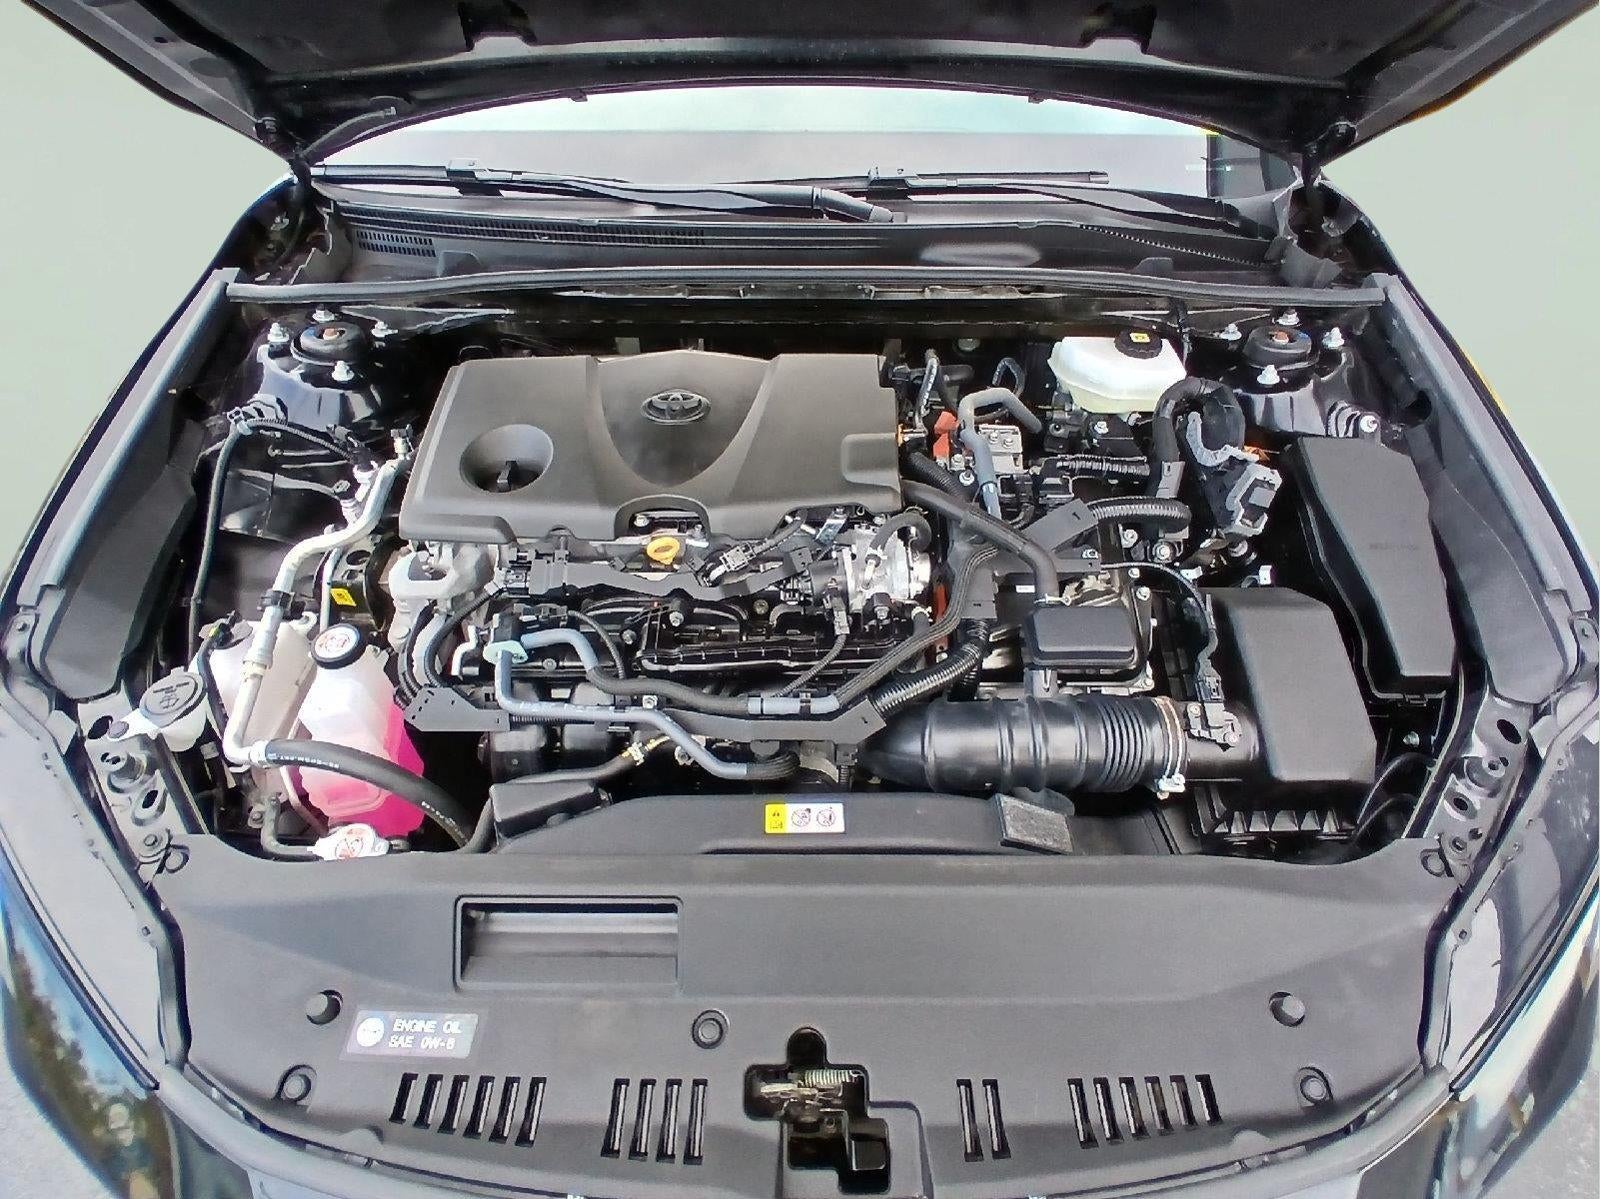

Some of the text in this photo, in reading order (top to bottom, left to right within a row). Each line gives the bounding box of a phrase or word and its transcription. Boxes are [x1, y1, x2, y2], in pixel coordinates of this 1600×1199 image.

[393, 1018, 463, 1034] ENGINE OIL
[388, 1034, 414, 1048] SAE
